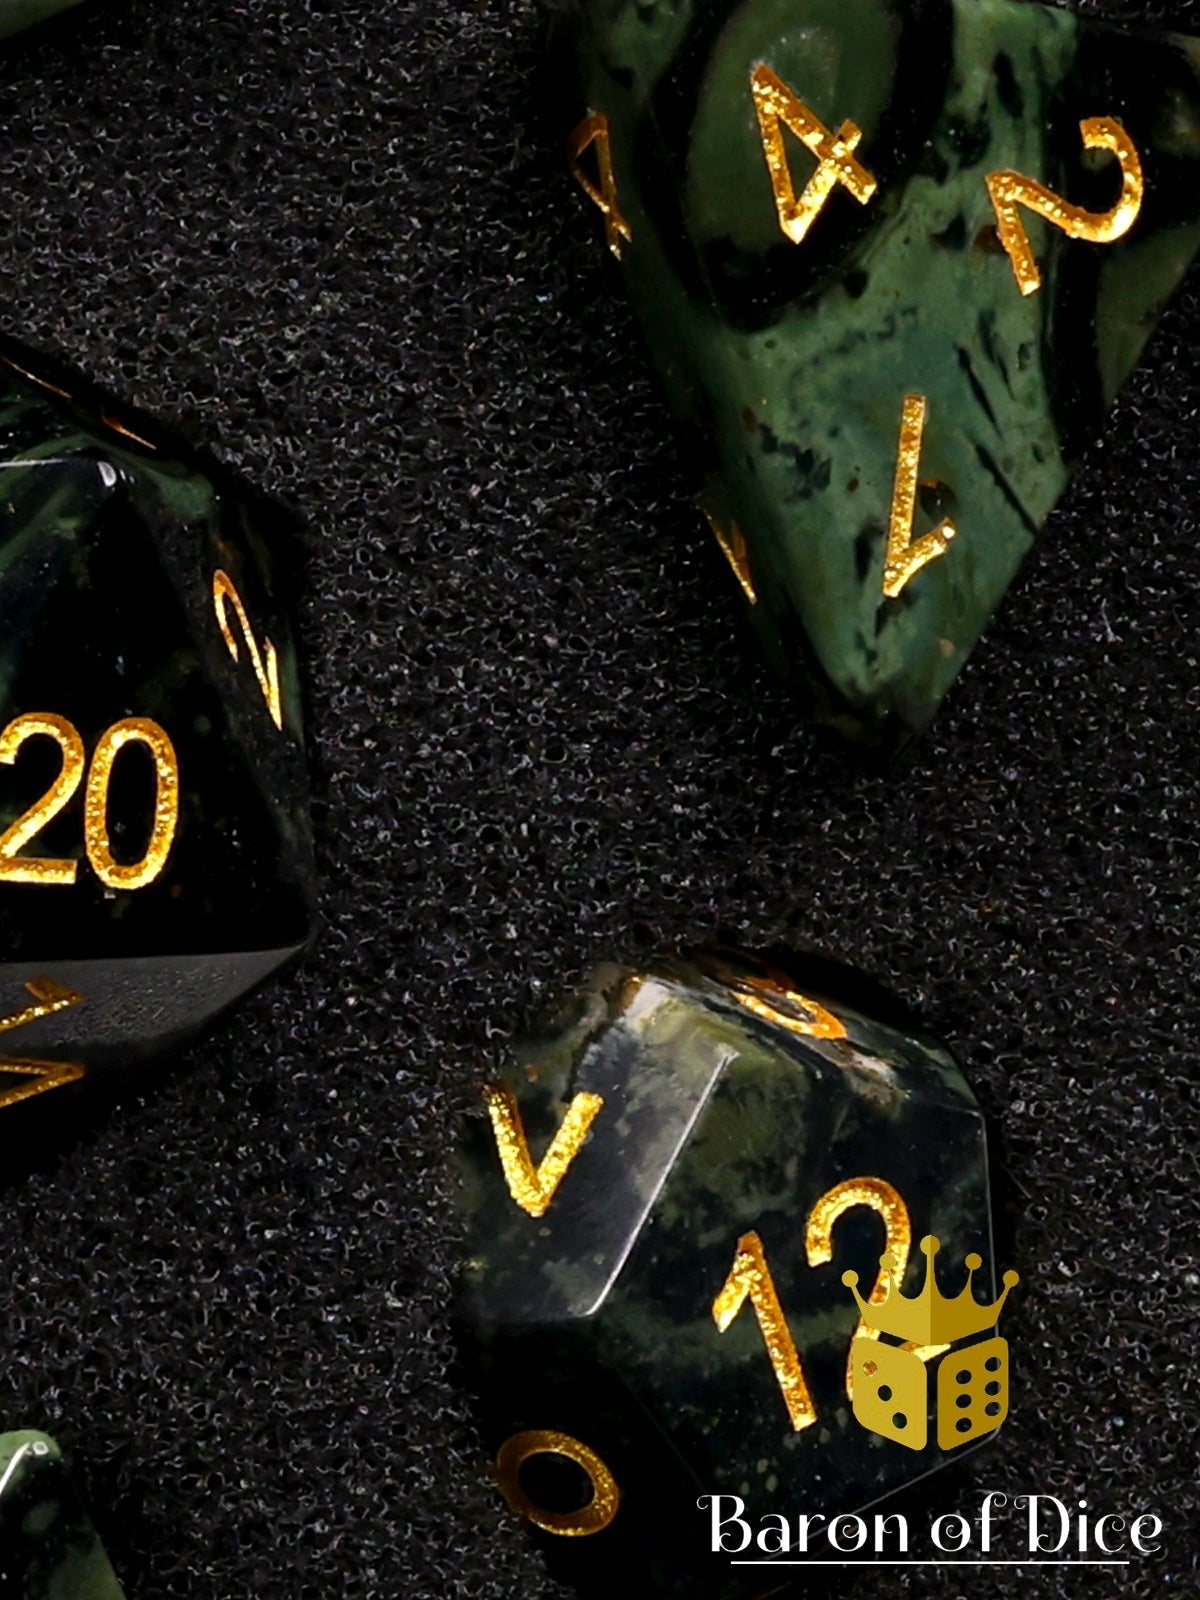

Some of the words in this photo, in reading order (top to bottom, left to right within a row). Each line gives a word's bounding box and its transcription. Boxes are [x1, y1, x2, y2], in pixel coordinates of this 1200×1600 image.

[750, 62, 877, 244] 4
[985, 115, 1144, 295] 2
[882, 394, 956, 598] 1
[212, 568, 282, 731] 2
